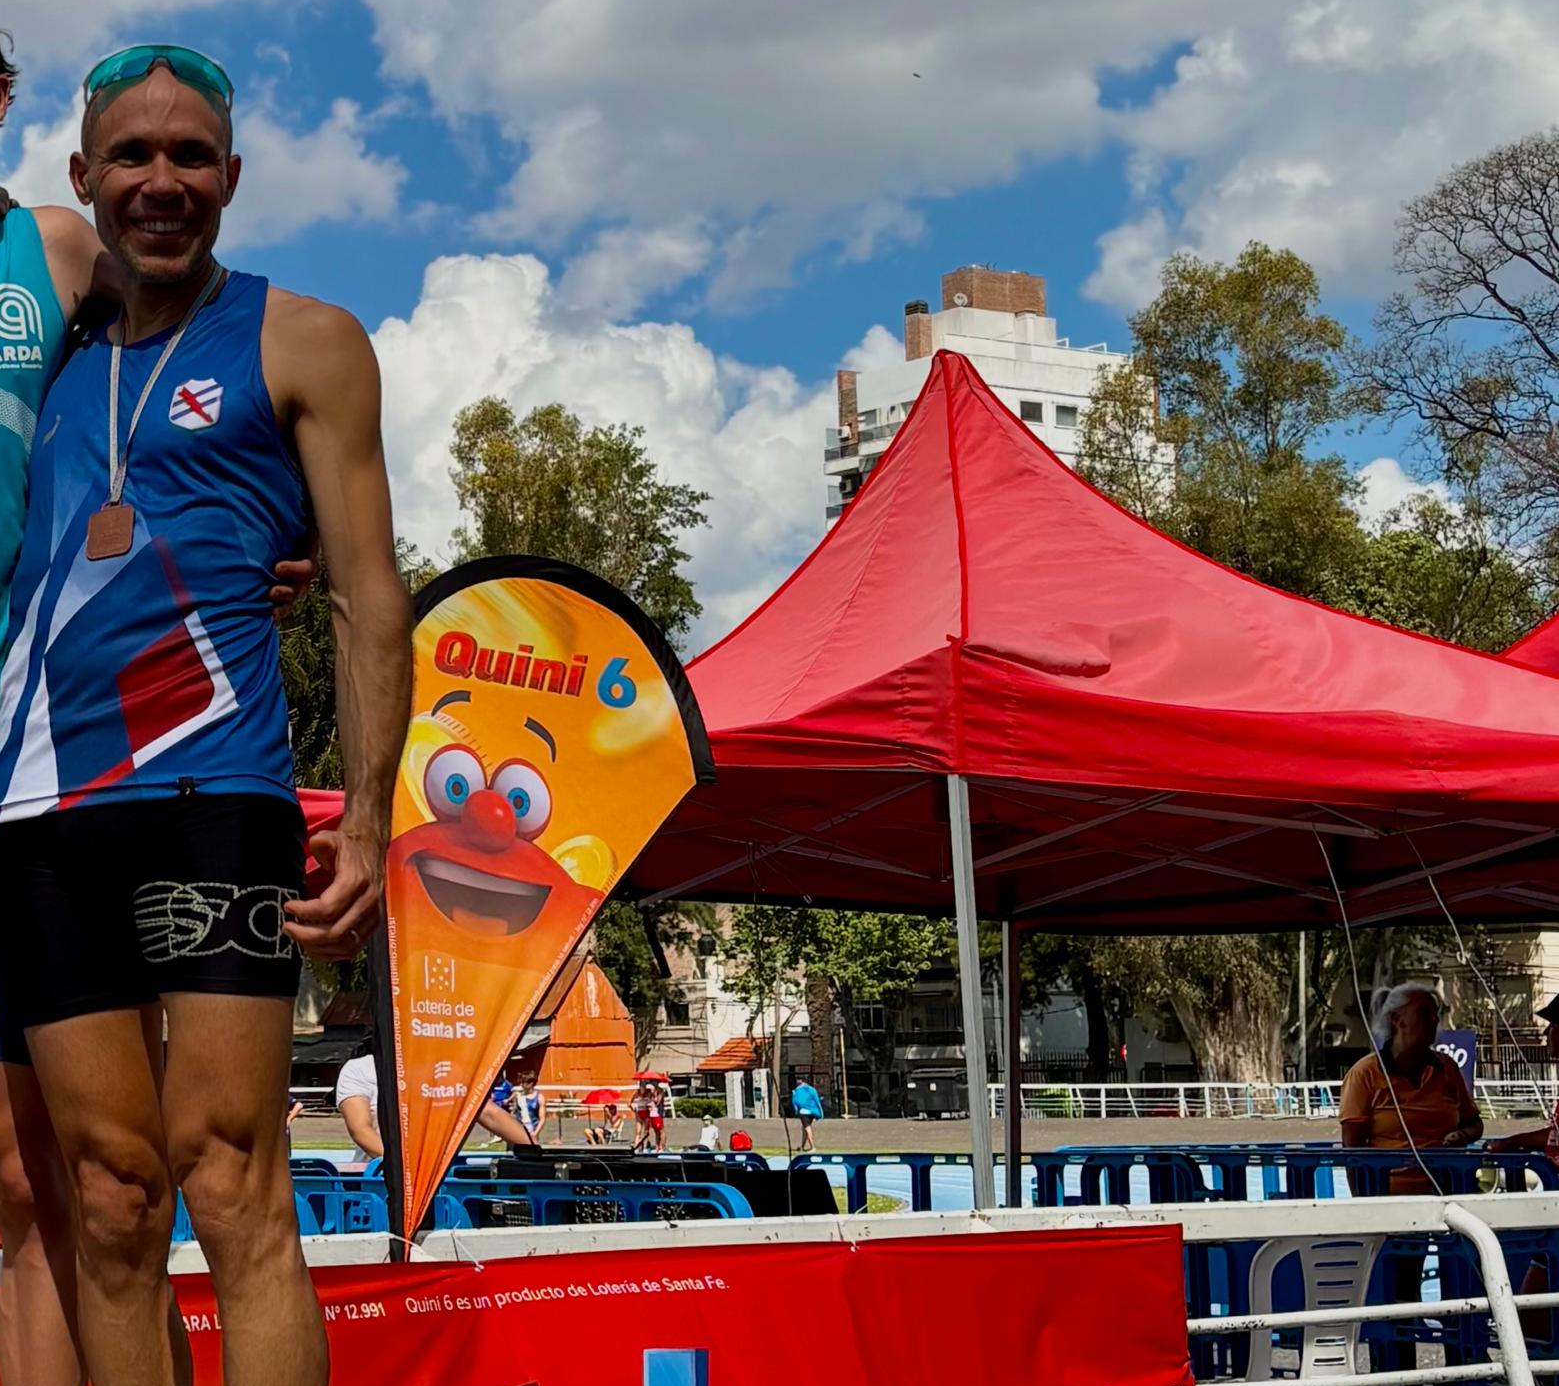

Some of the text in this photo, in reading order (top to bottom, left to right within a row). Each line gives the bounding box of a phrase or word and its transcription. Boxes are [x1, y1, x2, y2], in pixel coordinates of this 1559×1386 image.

[434, 631, 637, 708] Quini 6
[410, 997, 475, 1017] Lotería de
[411, 1019, 476, 1039] Santa Fe
[421, 1083, 468, 1098] Santa Fe
[404, 1274, 730, 1316] Quini 6 es un producto de Lotería de Santa Fe.
[183, 1314, 211, 1332] ARA
[214, 1314, 223, 1331] L
[344, 1302, 386, 1321] 12.991
